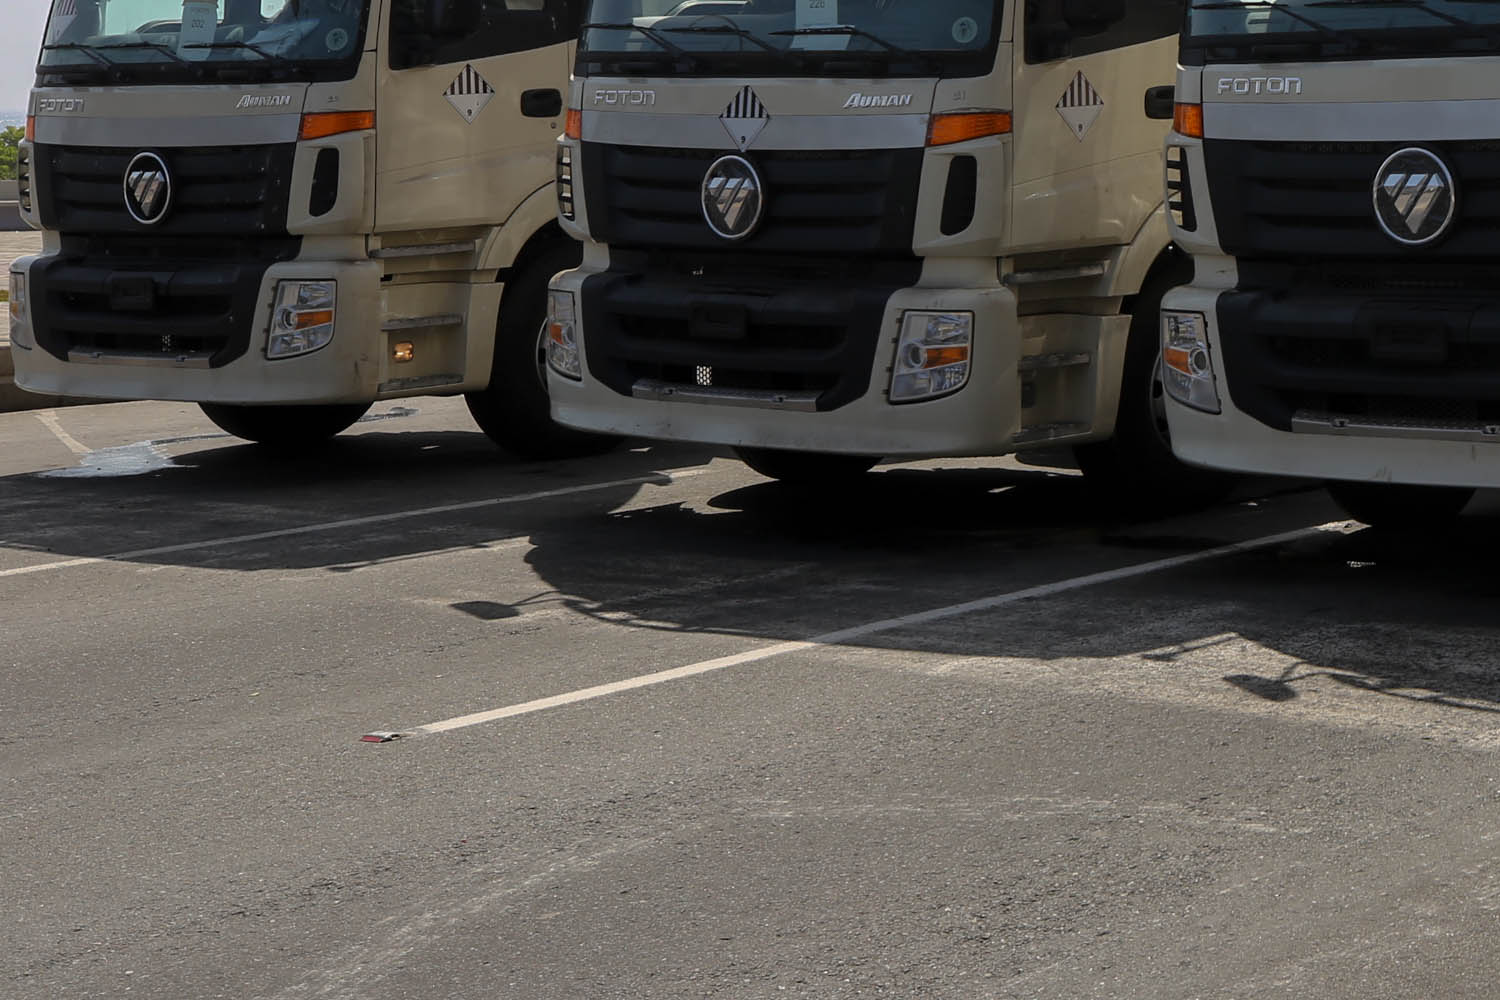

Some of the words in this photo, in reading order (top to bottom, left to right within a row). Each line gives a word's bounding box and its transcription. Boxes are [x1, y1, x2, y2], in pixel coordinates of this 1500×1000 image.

[1217, 77, 1303, 96] FOTON
[235, 94, 292, 109] AUMAN
[594, 89, 656, 105] FOTON
[842, 92, 912, 109] AUMAN
[39, 98, 85, 112] FOTON
[740, 135, 746, 144] 9
